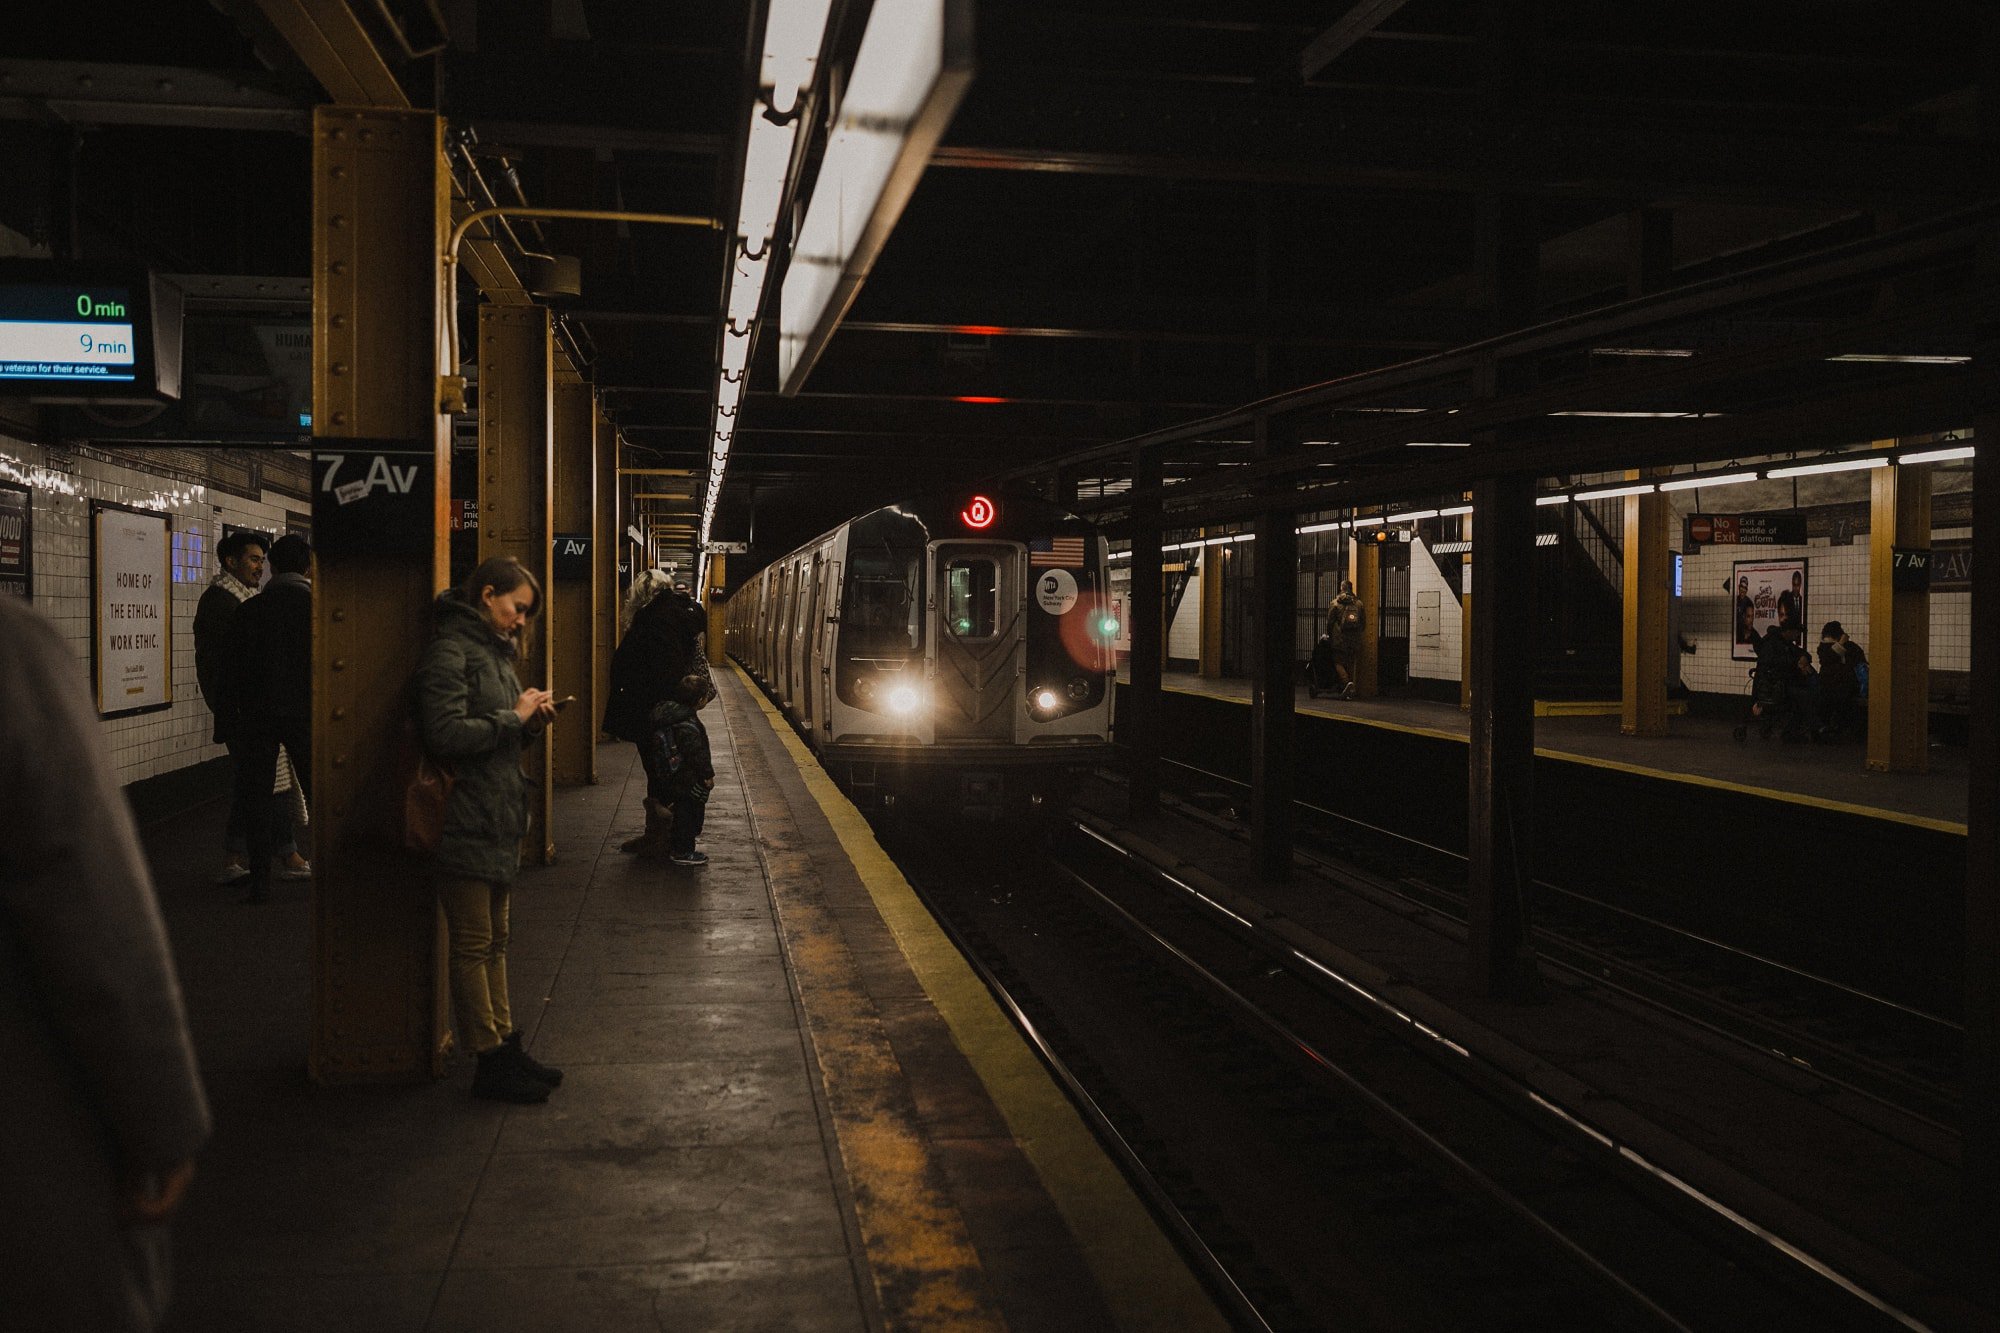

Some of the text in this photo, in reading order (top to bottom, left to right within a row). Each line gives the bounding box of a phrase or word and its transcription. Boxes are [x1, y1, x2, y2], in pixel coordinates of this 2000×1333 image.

[77, 294, 126, 318] 0 min
[80, 333, 127, 353] 9 min
[4, 364, 37, 373] veteran
[39, 364, 52, 373] for
[53, 364, 73, 373] their
[74, 365, 109, 375] service.
[317, 454, 419, 494] 7 Av
[1714, 518, 1730, 528] No
[1739, 518, 1766, 526] Exit at
[1714, 530, 1737, 543] Exit
[1739, 526, 1777, 535] middle of
[1740, 534, 1774, 543] platform
[563, 540, 586, 555] Av
[1894, 553, 1904, 568] 7
[1908, 553, 1926, 568] Av
[116, 572, 152, 589] HOME OF
[110, 603, 158, 619] THE ETHICAL
[110, 634, 159, 650] WORK ETHIC.
